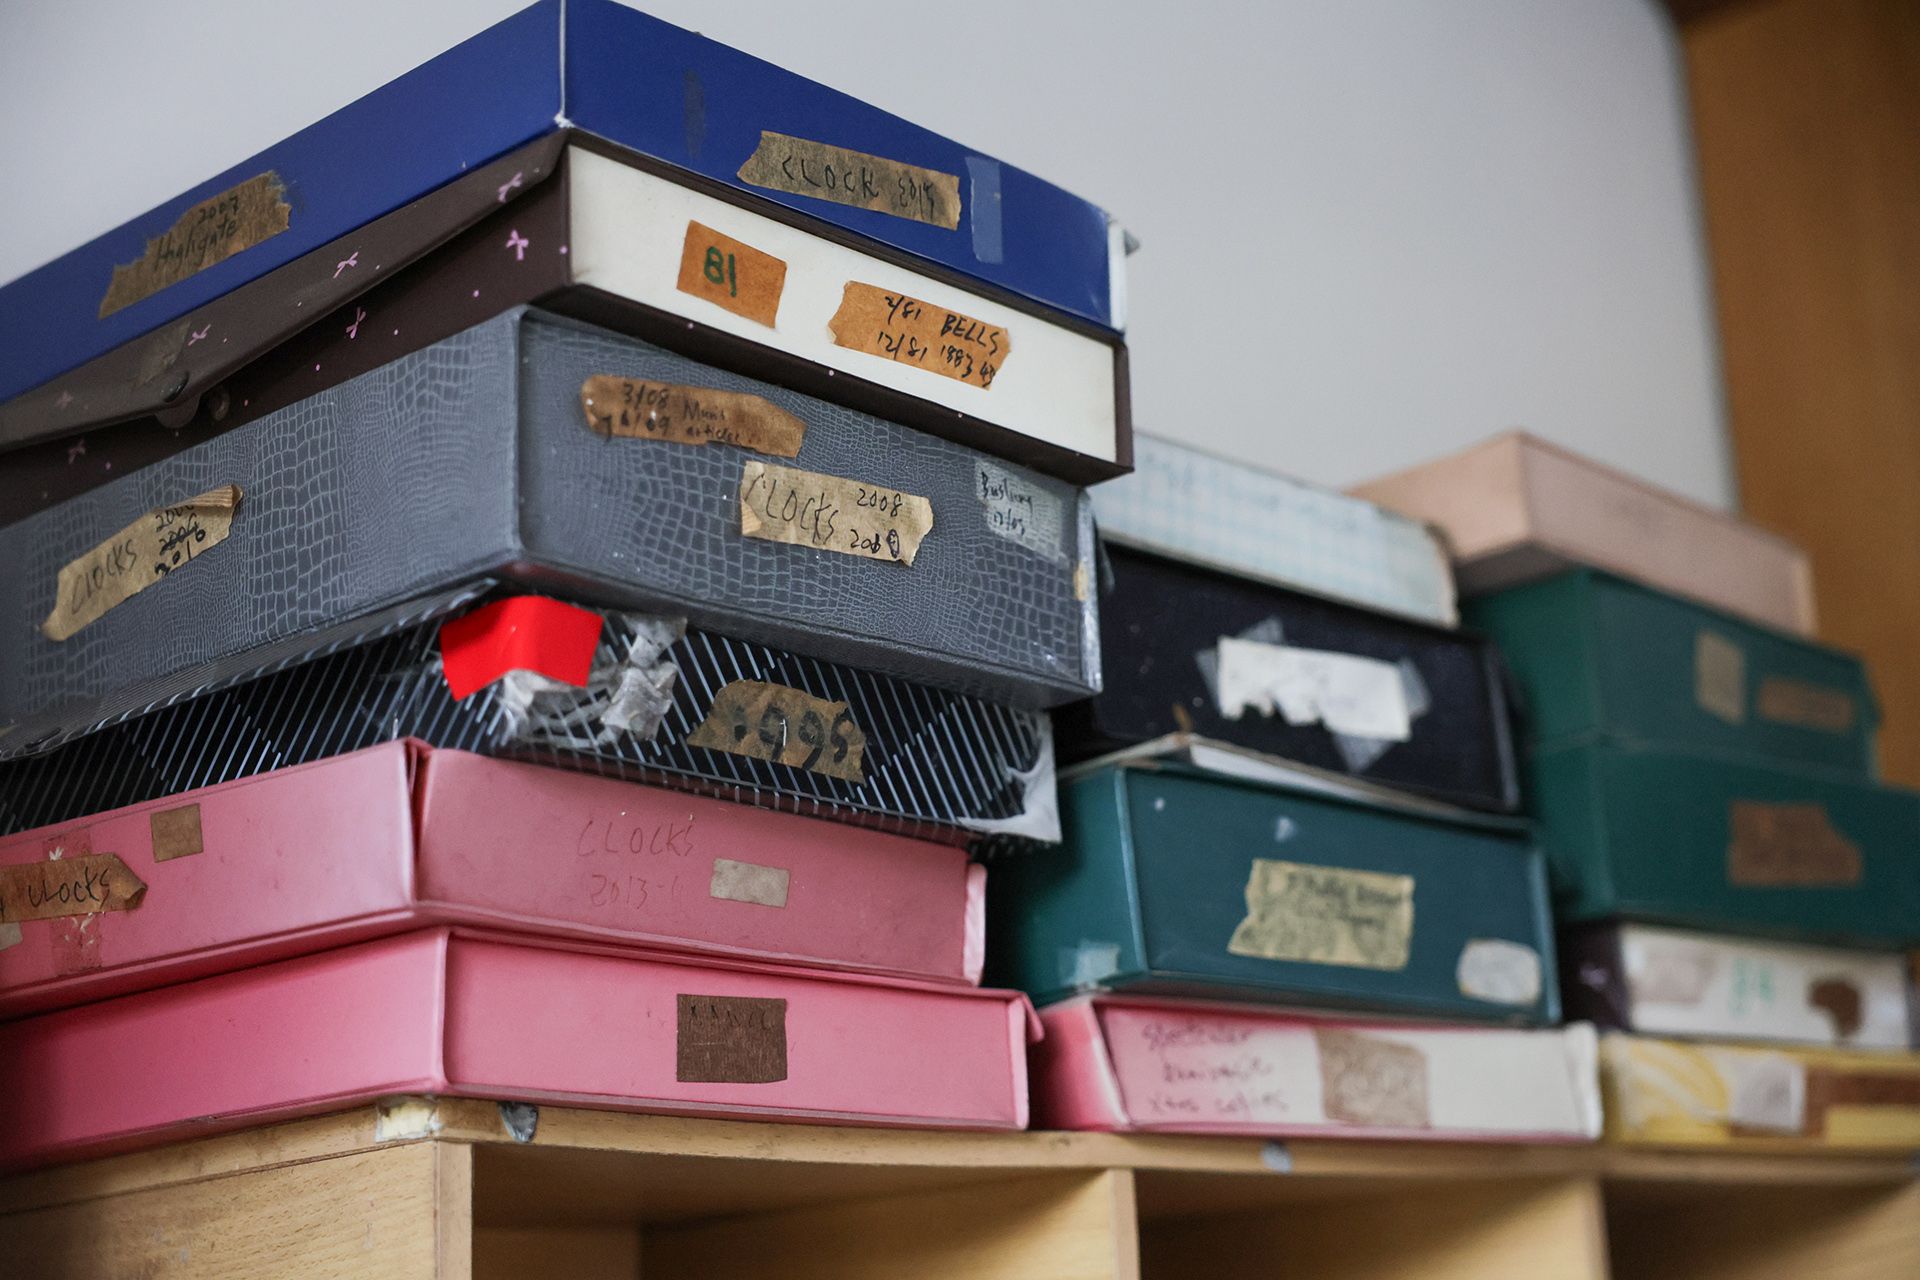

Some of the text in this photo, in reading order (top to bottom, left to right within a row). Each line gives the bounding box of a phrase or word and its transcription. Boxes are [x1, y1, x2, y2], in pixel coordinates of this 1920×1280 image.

[782, 156, 879, 198] CLOCK
[940, 313, 999, 356] BELLS
[857, 488, 903, 517] 2008
[577, 820, 695, 857] CLOCKS
